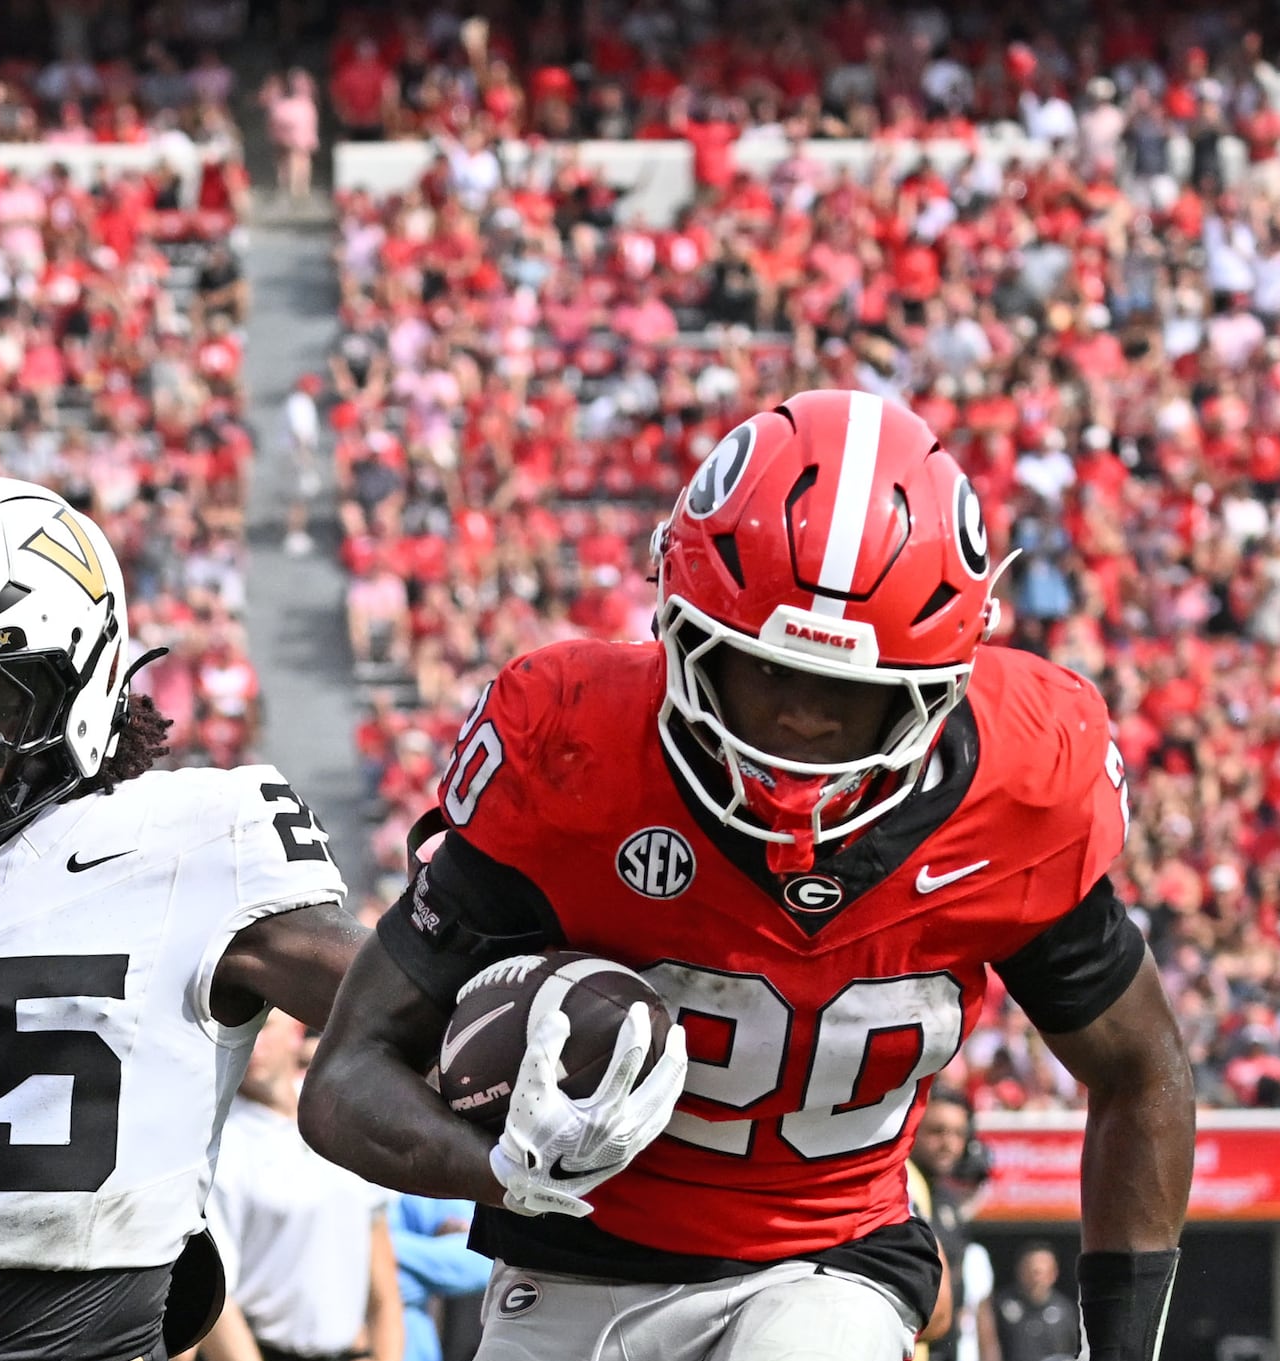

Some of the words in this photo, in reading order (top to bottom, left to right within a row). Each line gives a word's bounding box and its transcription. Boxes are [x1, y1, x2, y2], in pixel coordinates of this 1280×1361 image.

[785, 622, 860, 651] DAWGS
[623, 832, 689, 896] SEC
[644, 957, 964, 1162] 20
